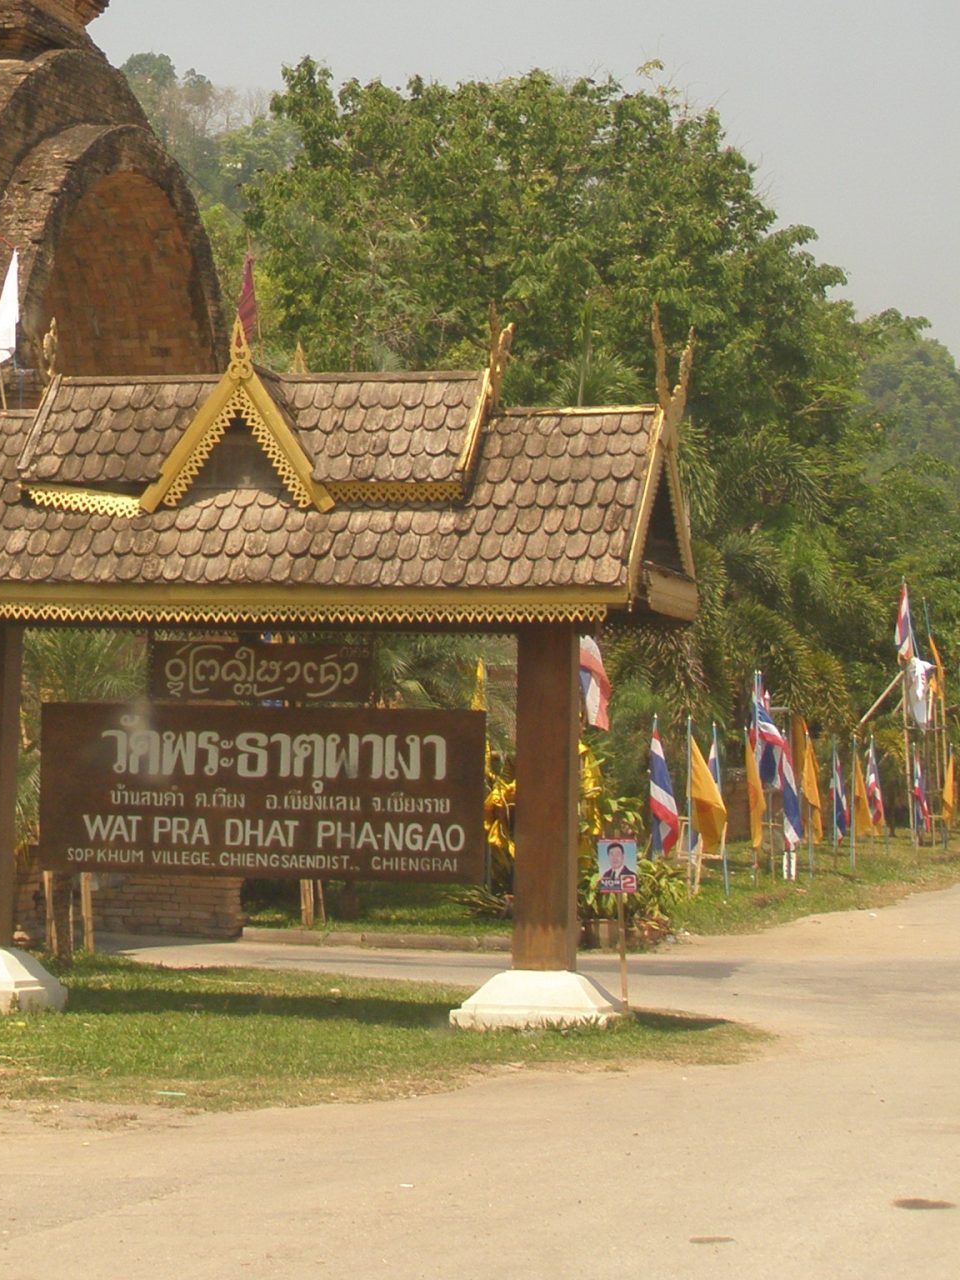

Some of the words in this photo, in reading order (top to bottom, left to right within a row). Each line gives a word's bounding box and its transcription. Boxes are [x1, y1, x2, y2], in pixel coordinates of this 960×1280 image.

[101, 714, 447, 794] วัดพระธาตุผาเงา
[83, 814, 142, 843] WAT
[153, 816, 210, 846] PRA
[225, 818, 299, 848] DHAT
[317, 821, 466, 852] PHA-NGAO
[371, 856, 458, 873] CHIENGRAI
[622, 875, 636, 889] 2
